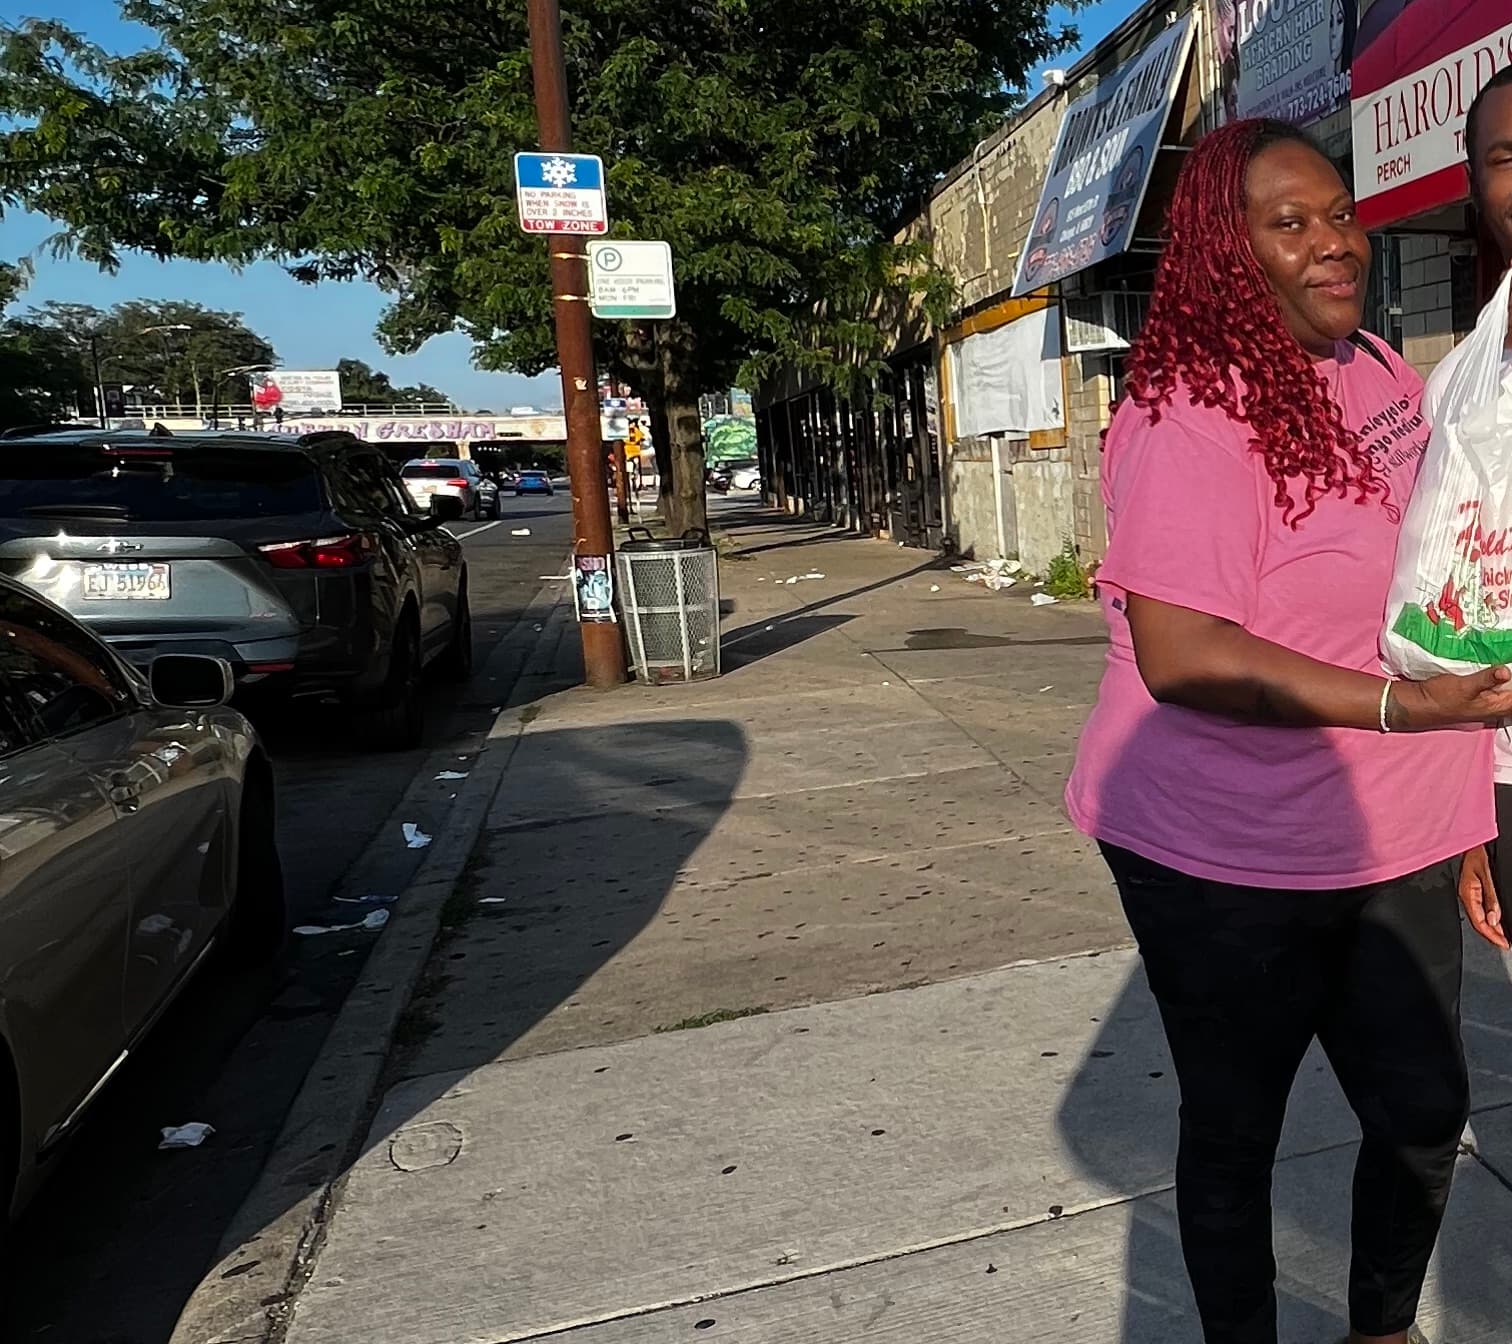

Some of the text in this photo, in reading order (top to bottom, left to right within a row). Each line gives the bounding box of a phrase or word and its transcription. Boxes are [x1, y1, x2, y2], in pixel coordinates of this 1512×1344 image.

[1377, 152, 1412, 185] PERCH
[540, 191, 576, 200] PARKING
[526, 199, 550, 207] WHEN
[554, 200, 577, 208] SNOW
[526, 208, 548, 216] OVER
[562, 209, 593, 217] INCHES
[527, 219, 599, 231] TOW ZONE
[376, 421, 498, 442] GRESHAM
